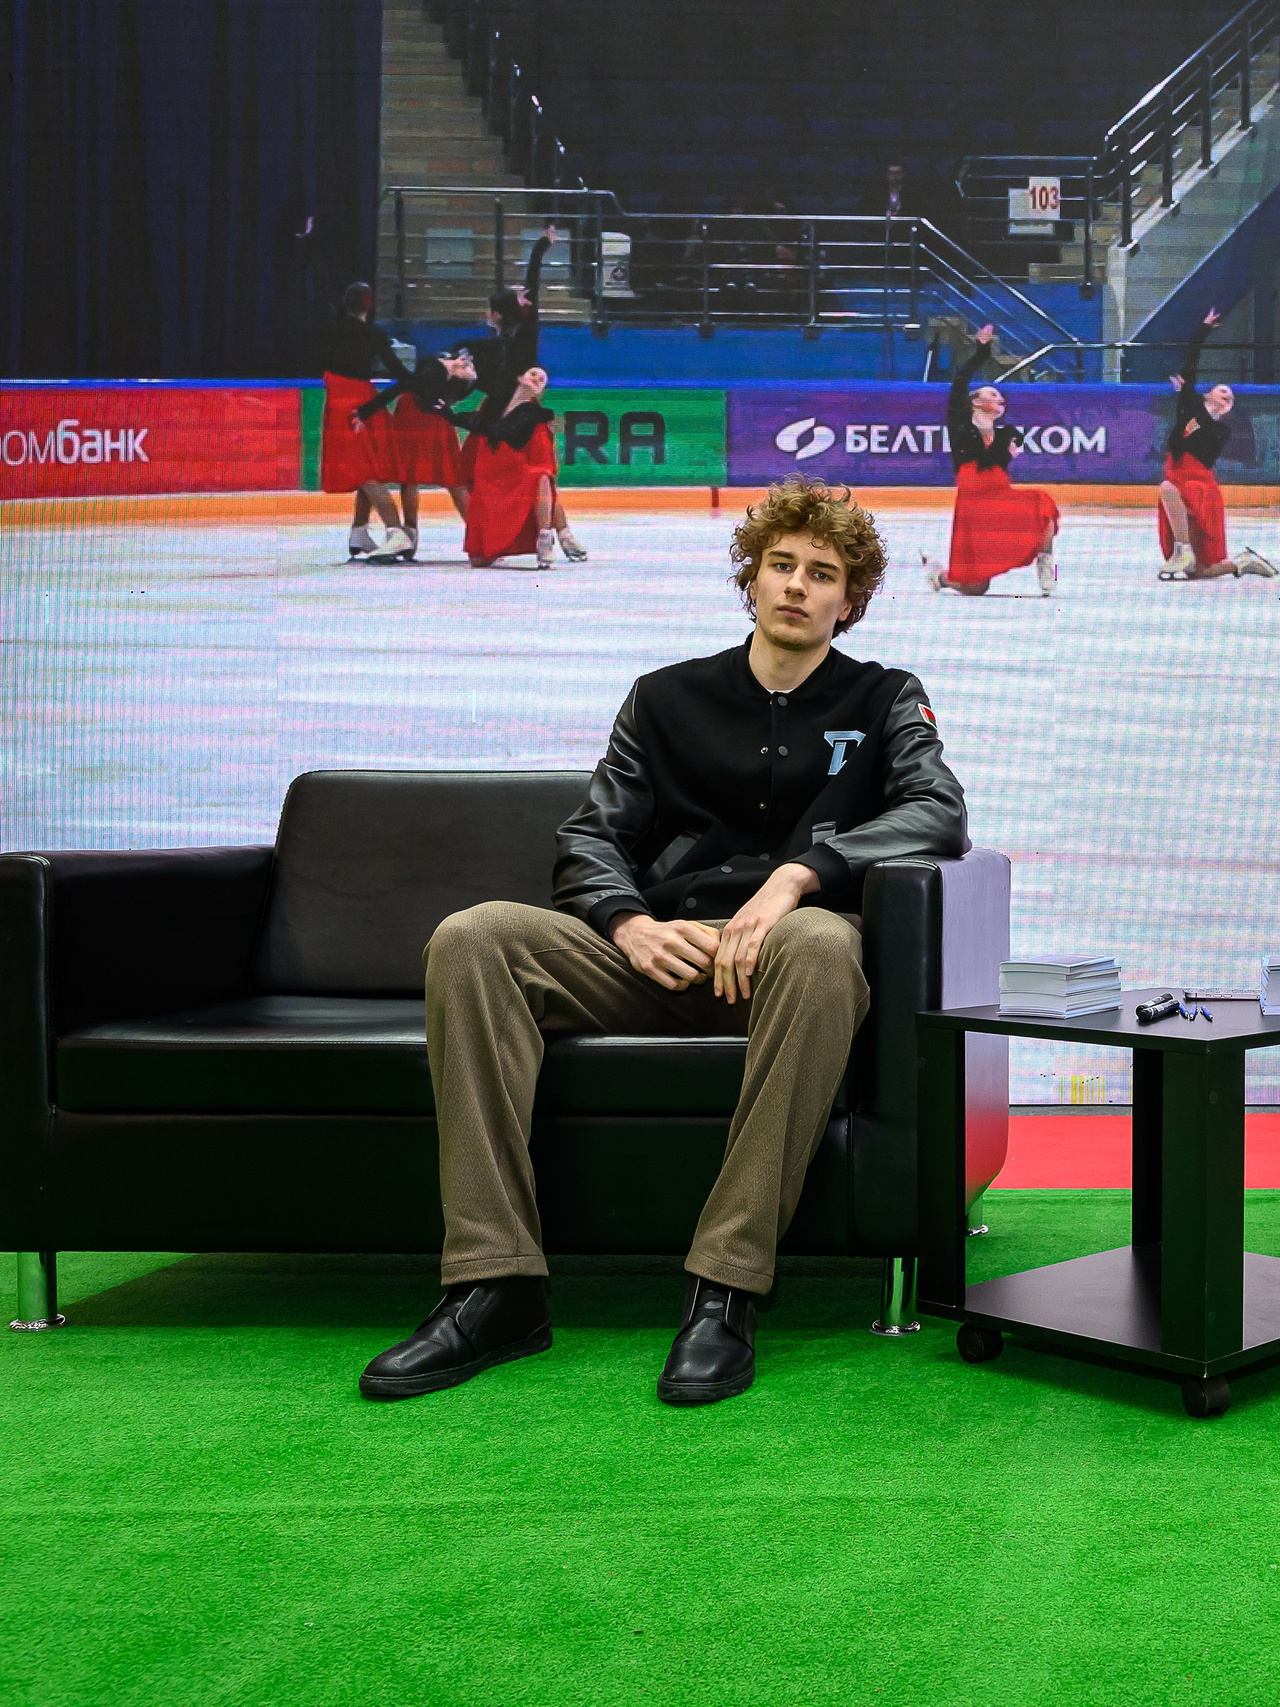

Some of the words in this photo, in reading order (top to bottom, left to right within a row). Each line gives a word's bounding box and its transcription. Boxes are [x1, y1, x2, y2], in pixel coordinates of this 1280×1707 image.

[1029, 186, 1060, 209] 103
[0, 418, 149, 466] омбанк
[845, 424, 1107, 454] БЕЛТКОМ
